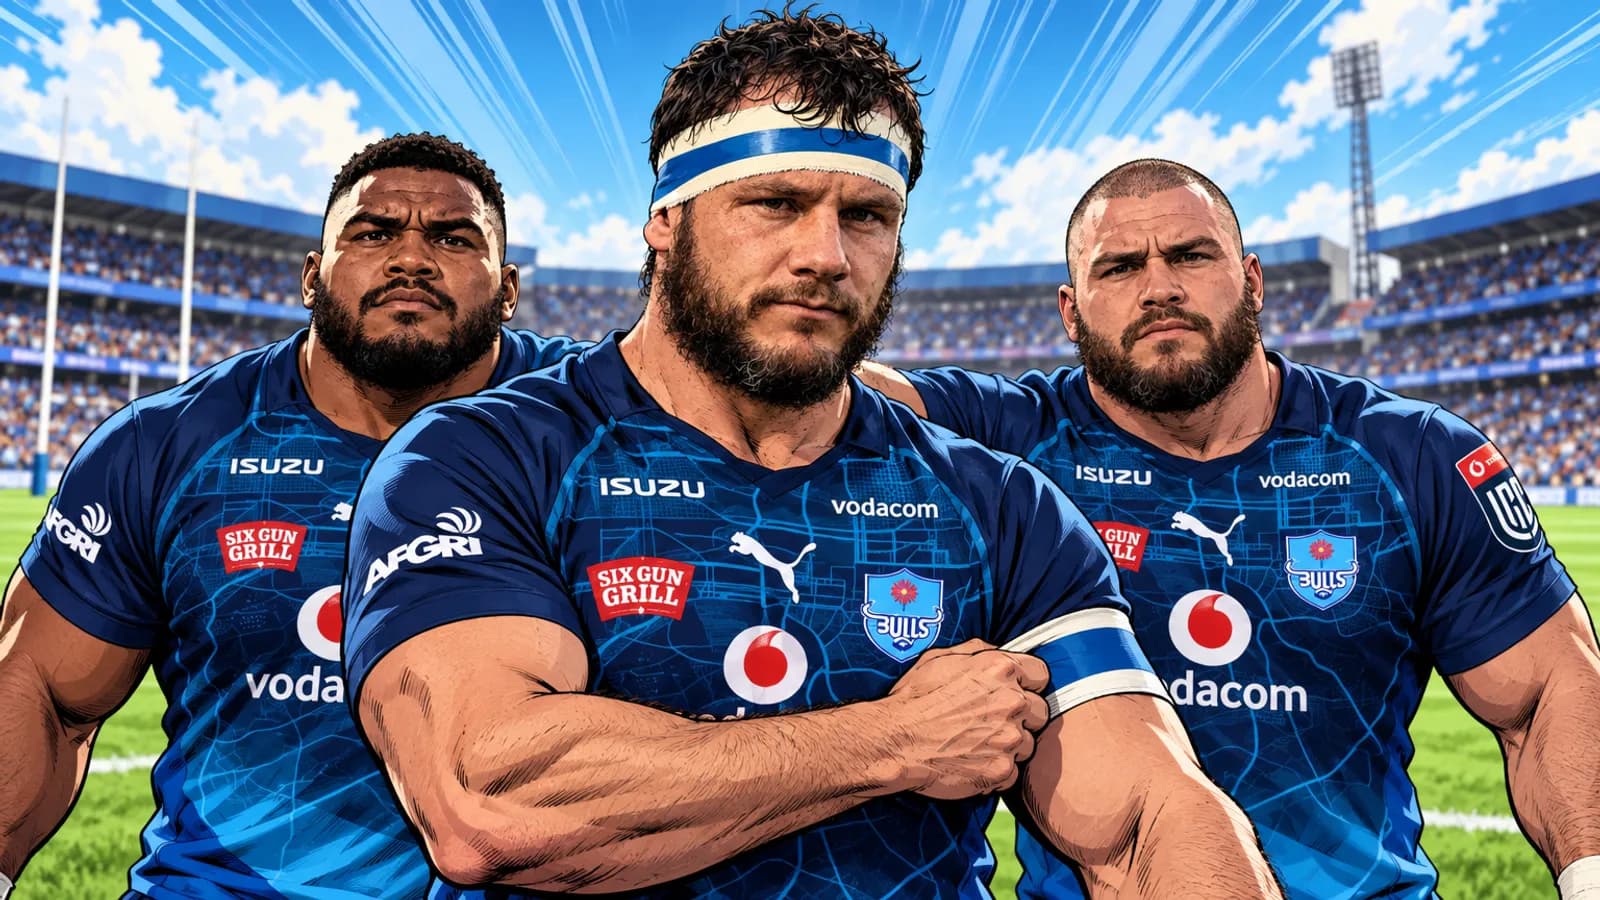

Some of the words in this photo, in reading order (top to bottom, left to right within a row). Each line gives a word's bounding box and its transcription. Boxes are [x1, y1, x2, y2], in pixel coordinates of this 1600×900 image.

[230, 458, 324, 475] ISUZU
[1076, 465, 1152, 486] ISUZU
[600, 477, 705, 499] ISUZU
[1259, 471, 1351, 489] vodacom
[832, 497, 938, 519] vodacom
[224, 528, 256, 547] SIX
[258, 528, 299, 545] GUN
[1105, 528, 1141, 546] GUN
[228, 543, 293, 562] GRILL
[363, 535, 484, 597] AFGRI
[597, 565, 635, 588] SIX
[636, 565, 685, 587] GUN
[1298, 570, 1347, 590] BULLS
[602, 583, 679, 608] GRILL
[876, 615, 930, 639] BULLS
[1164, 670, 1308, 712] dacom
